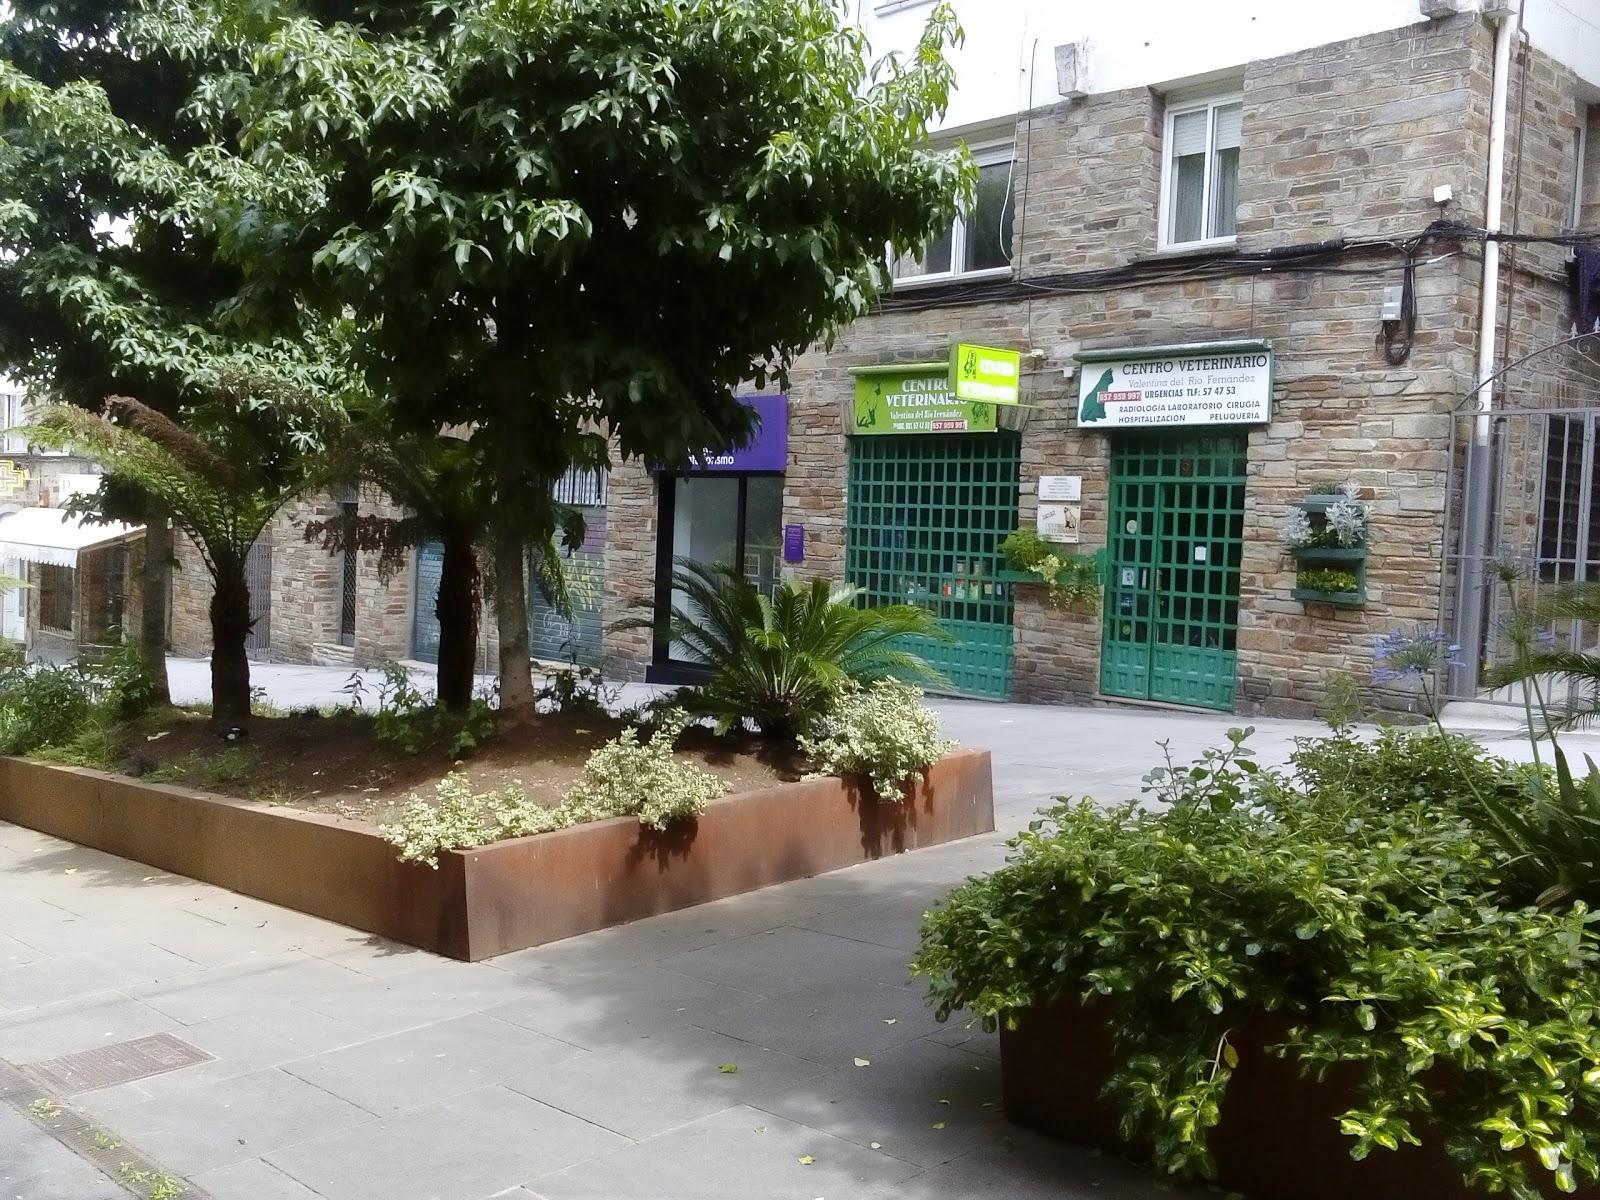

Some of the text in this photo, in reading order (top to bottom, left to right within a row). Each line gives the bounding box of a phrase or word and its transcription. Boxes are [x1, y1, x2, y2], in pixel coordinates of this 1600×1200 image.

[1122, 355, 1267, 375] CENTRO VETERINARIO
[1128, 379, 1167, 388] Valentina
[1170, 377, 1183, 386] del
[1145, 388, 1183, 398] URGENCIAS
[1187, 388, 1200, 396] TLF:
[1202, 387, 1212, 395] 57
[1214, 387, 1224, 395] 47
[1226, 386, 1236, 394] 53
[886, 393, 967, 407] VETERINAR
[1167, 402, 1223, 411] LABORATORIO
